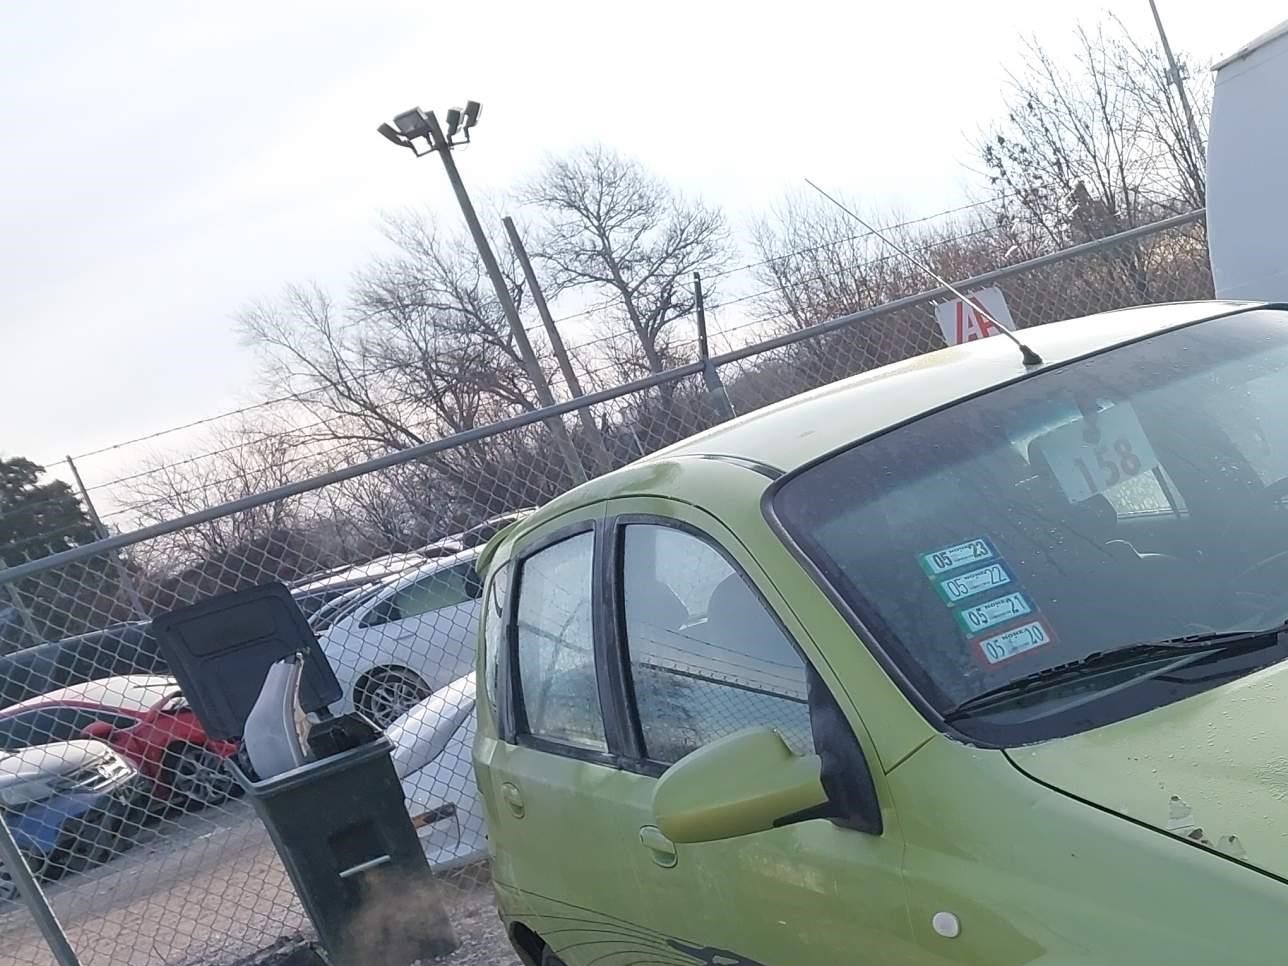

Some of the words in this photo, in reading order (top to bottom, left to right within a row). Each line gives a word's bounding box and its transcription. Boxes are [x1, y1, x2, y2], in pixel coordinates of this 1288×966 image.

[1073, 436, 1141, 494] 158
[933, 551, 953, 569] 05
[968, 541, 989, 558] 23
[947, 578, 969, 597] 05
[984, 566, 1008, 585] 22
[968, 607, 988, 626] 05
[1007, 595, 1026, 614] 21
[986, 639, 1006, 659] 05
[1024, 625, 1044, 645] 20
